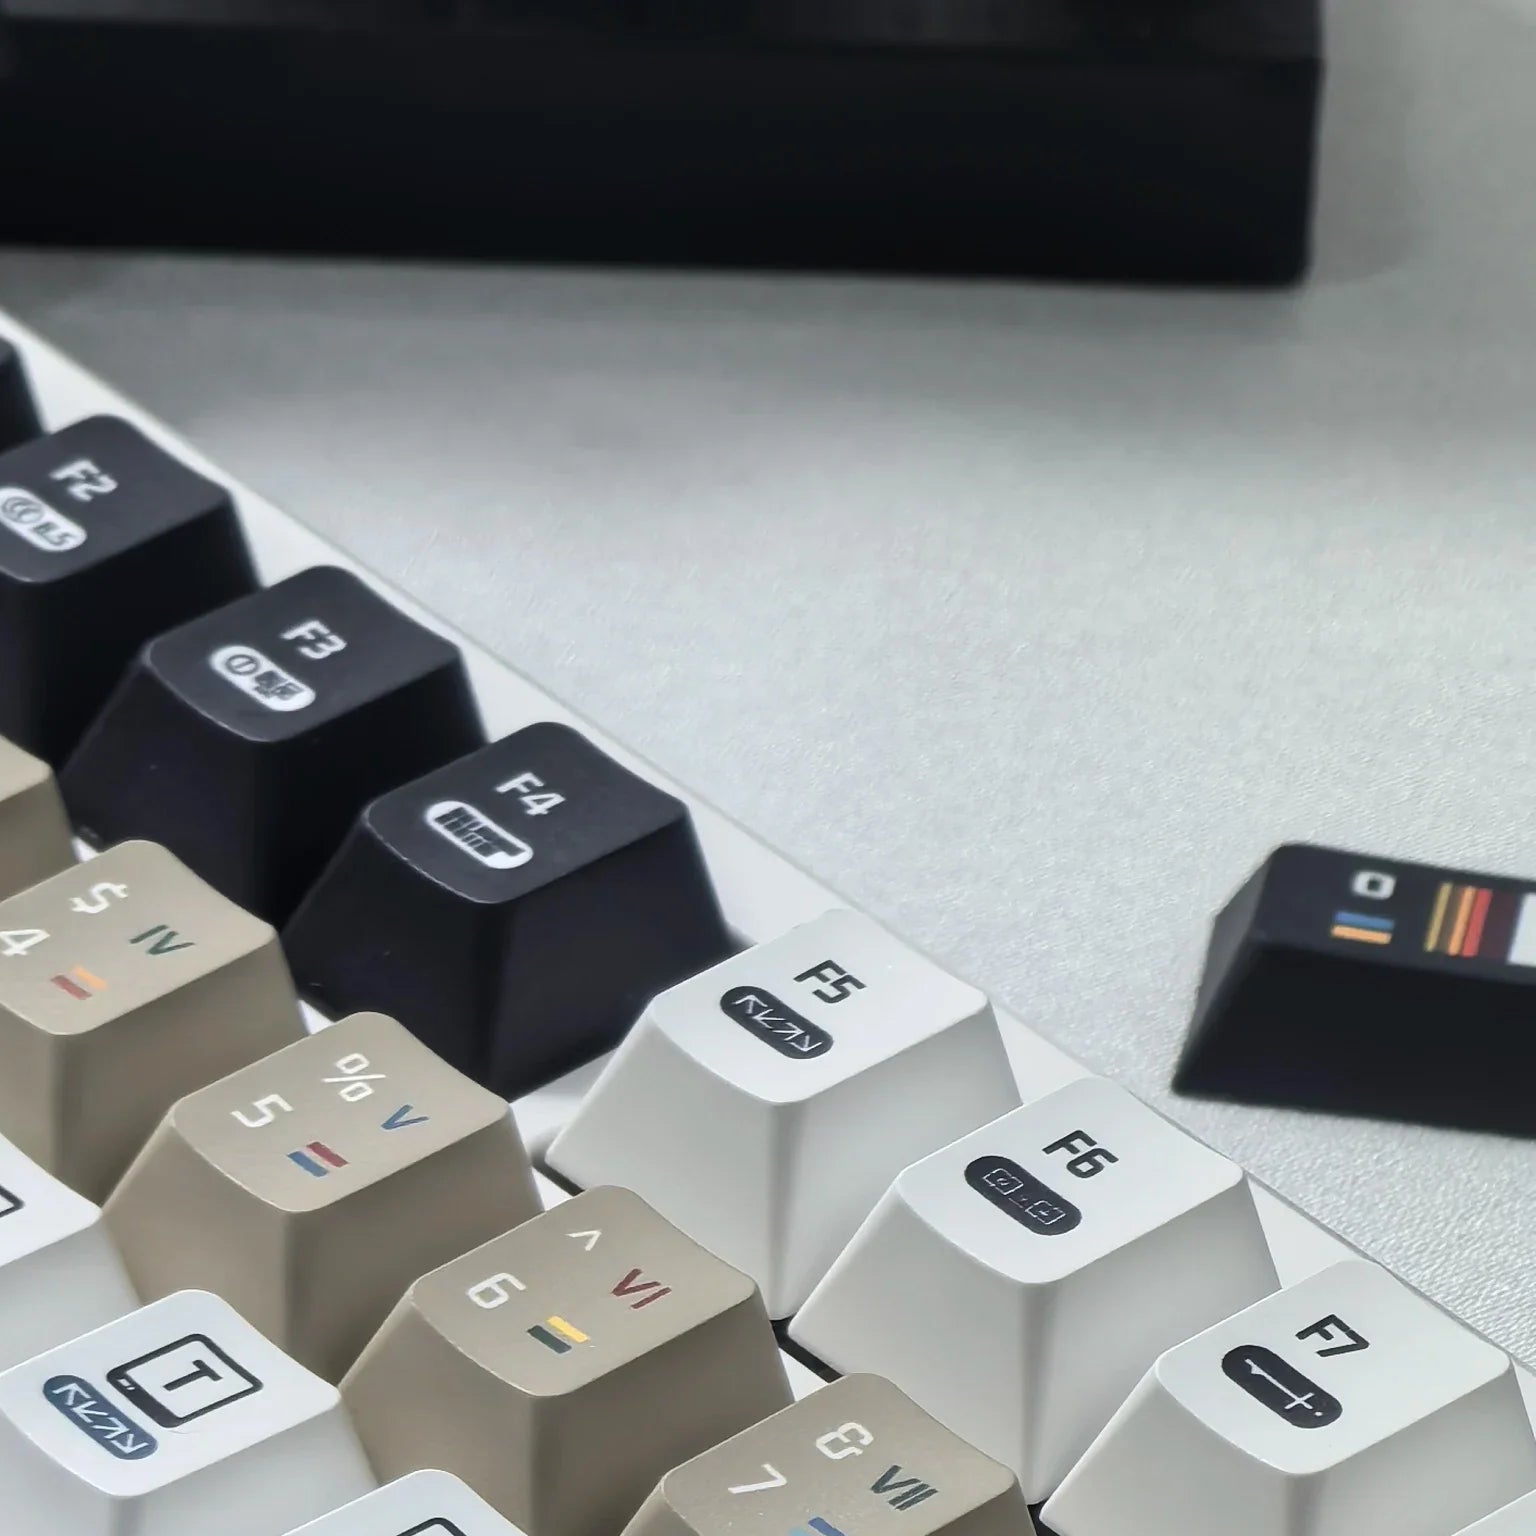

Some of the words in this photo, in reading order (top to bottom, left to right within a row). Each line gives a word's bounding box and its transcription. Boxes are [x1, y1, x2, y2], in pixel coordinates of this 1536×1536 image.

[52, 460, 117, 500] F2
[282, 621, 346, 659] F3
[496, 773, 565, 815] F4
[72, 883, 127, 913] $
[130, 925, 194, 955] IV
[794, 960, 866, 1003] F5
[323, 1053, 386, 1102] %
[231, 1094, 293, 1127] 5
[381, 1105, 428, 1129] V
[1042, 1130, 1118, 1178] F6
[467, 1273, 526, 1308] 6
[612, 1269, 671, 1309] VI
[1295, 1314, 1369, 1357] F7
[163, 1360, 222, 1391] T
[816, 1423, 873, 1459] &
[728, 1464, 787, 1493] 7
[871, 1465, 938, 1510] VII
